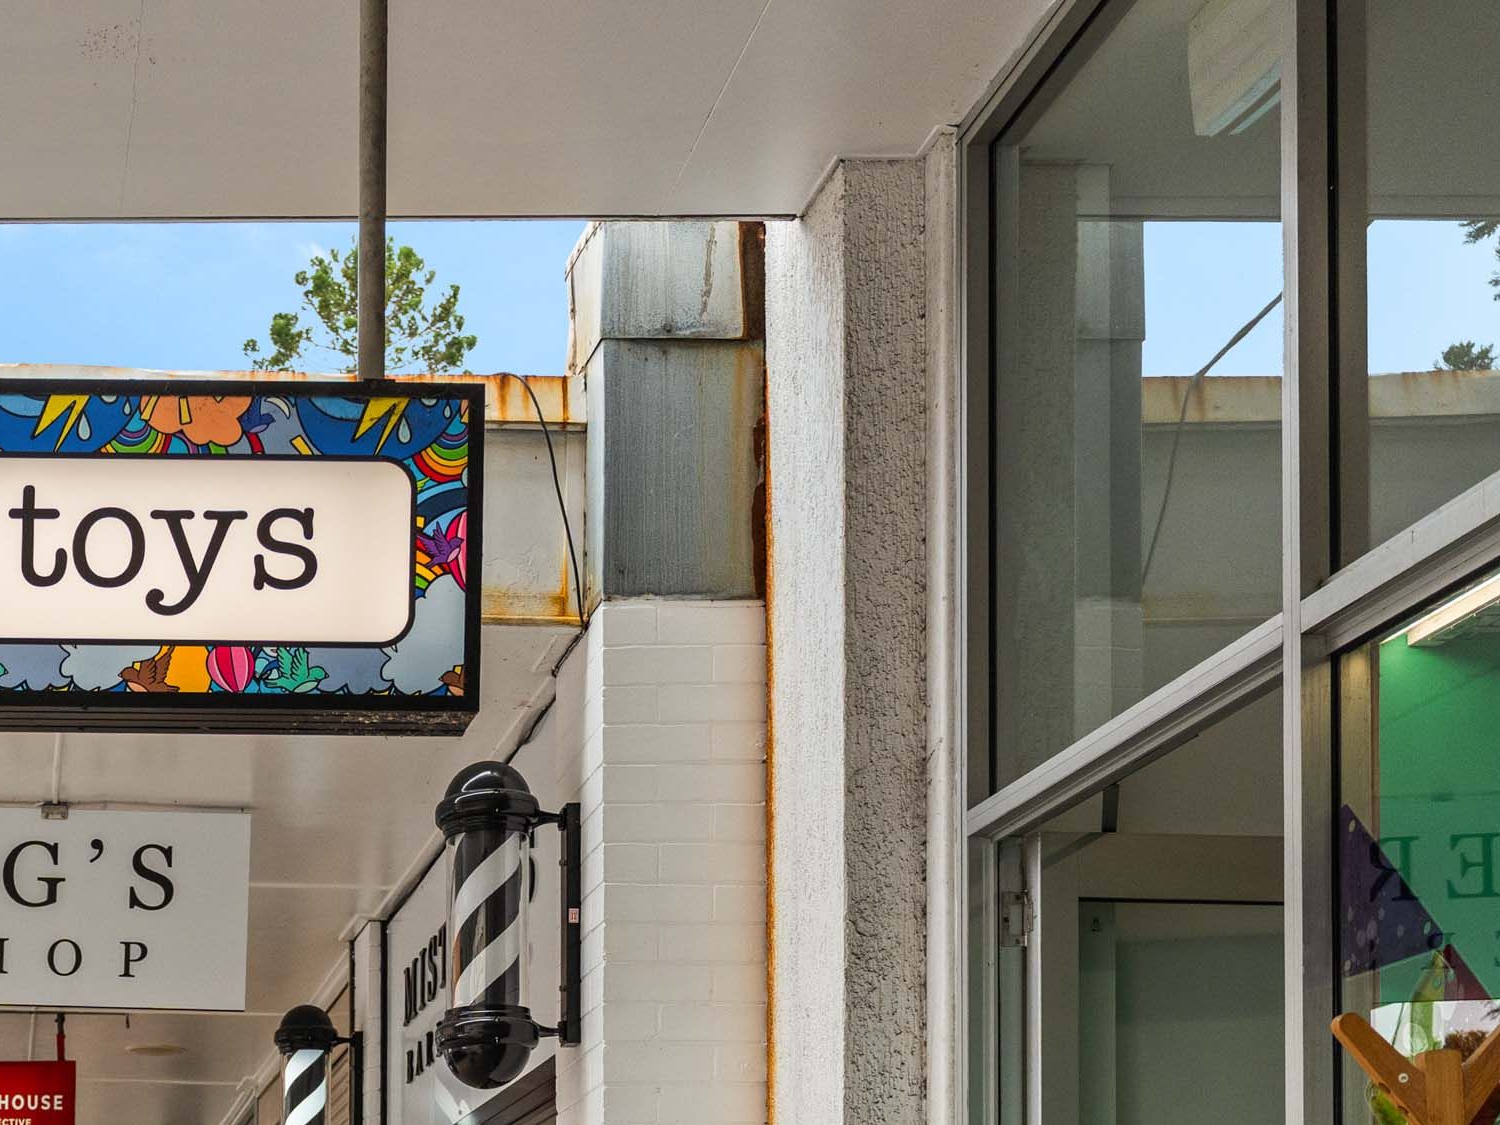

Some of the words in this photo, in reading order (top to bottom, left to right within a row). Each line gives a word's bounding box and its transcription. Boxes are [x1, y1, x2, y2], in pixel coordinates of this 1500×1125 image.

[9, 483, 320, 616] toys
[2, 838, 176, 911] G'S
[403, 921, 447, 1027] MIST
